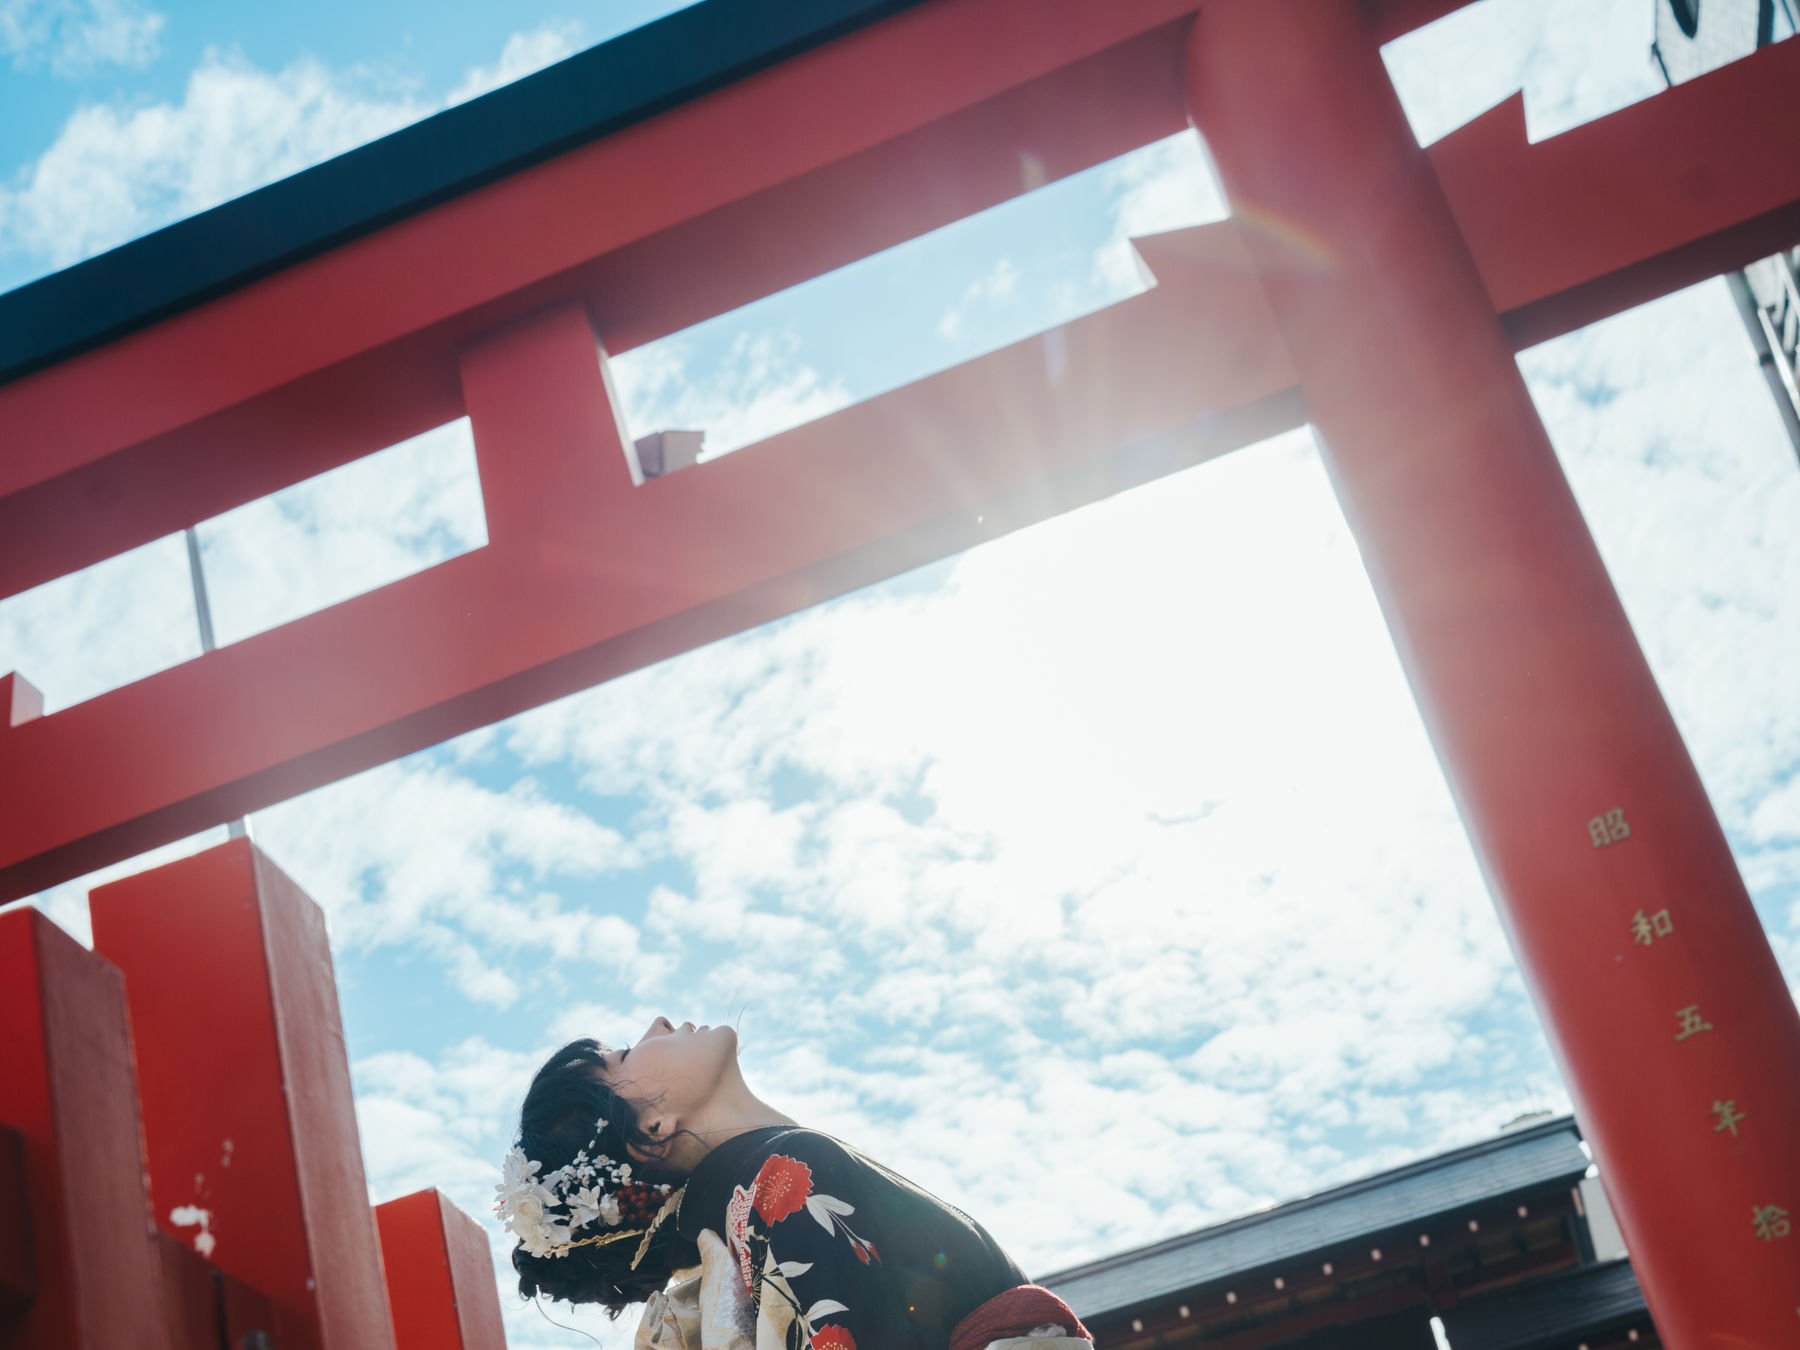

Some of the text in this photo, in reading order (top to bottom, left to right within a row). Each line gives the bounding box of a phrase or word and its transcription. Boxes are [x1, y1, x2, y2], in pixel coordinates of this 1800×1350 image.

[1587, 807, 1791, 1241] 昭和五年拾
